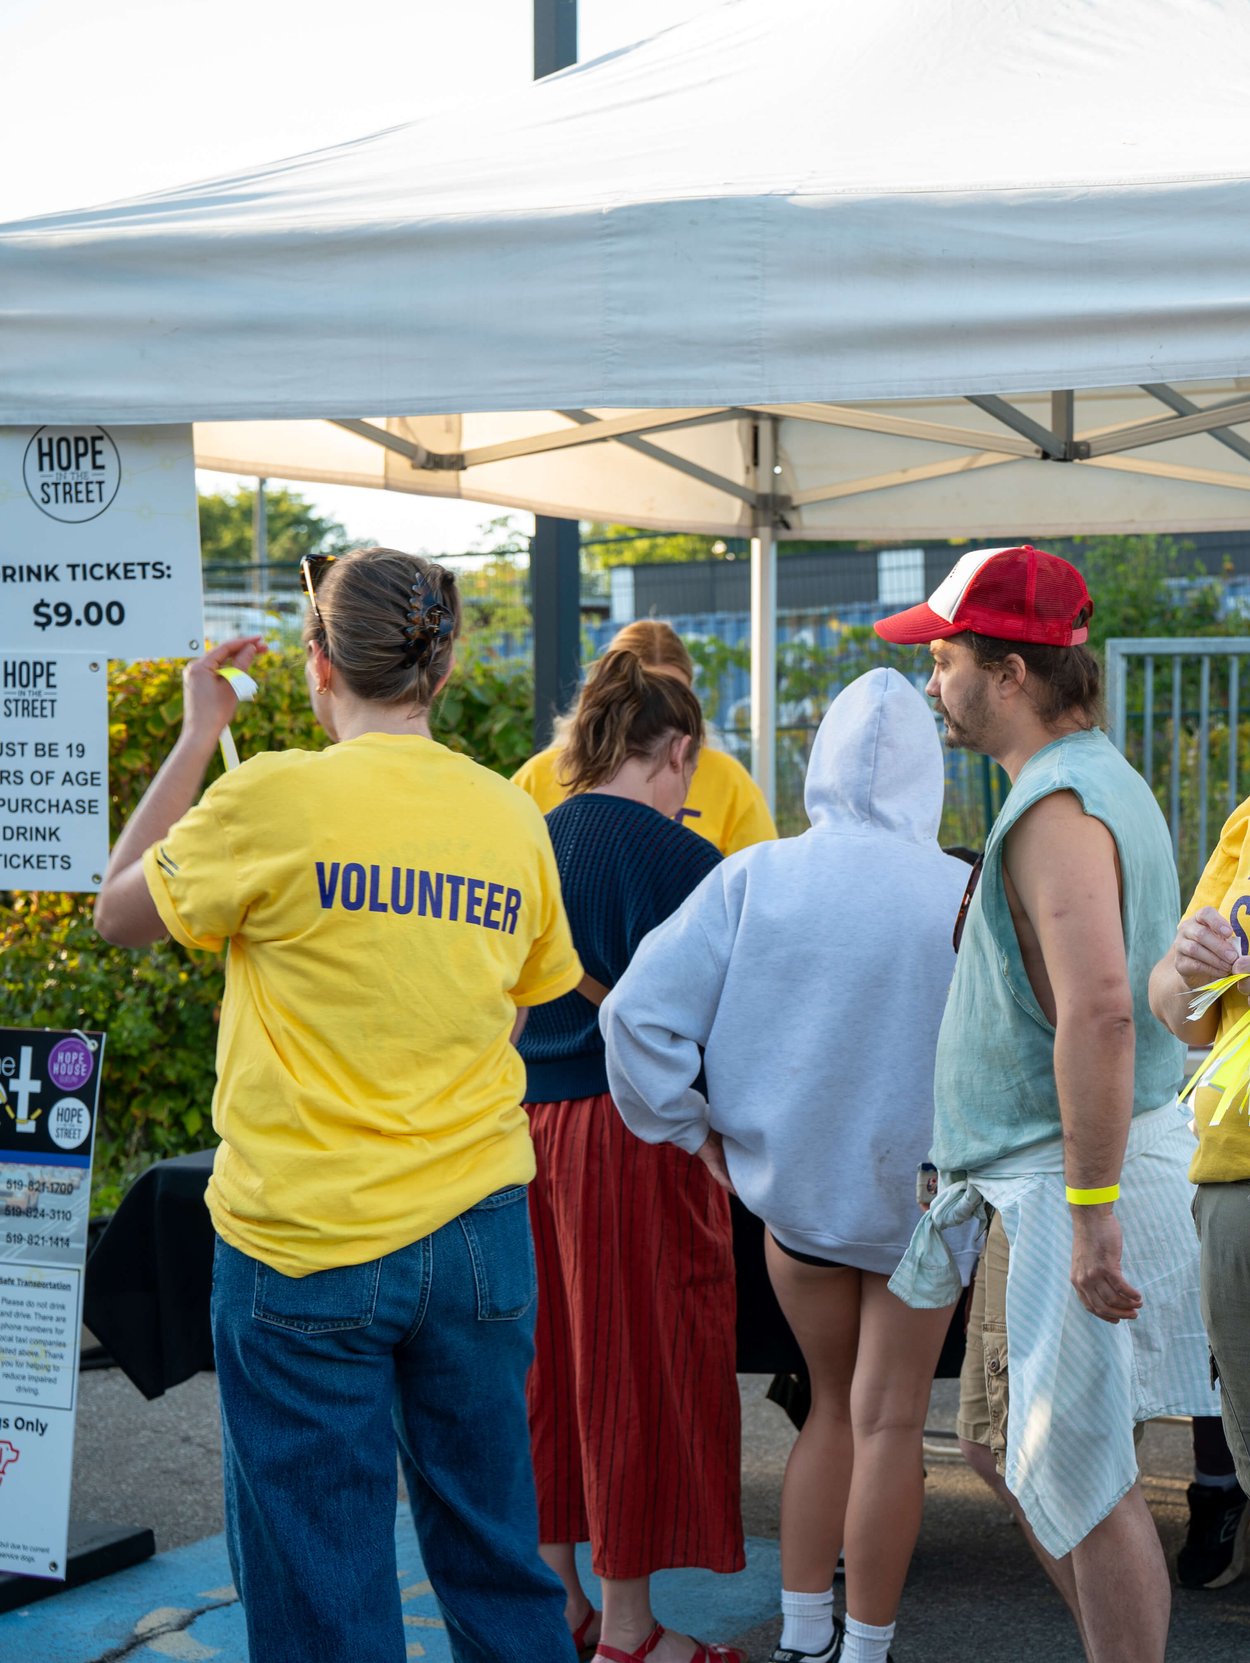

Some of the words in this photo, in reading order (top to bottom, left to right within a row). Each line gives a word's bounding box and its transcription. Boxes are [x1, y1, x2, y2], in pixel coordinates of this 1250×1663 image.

[37, 435, 106, 472] HOPE
[55, 472, 67, 481] IN
[71, 471, 89, 481] THE
[41, 480, 105, 504] STREET
[0, 563, 61, 582] RINK
[67, 561, 172, 581] TICKETS:
[33, 599, 125, 632] $9.00
[3, 660, 57, 689] HOPE
[28, 690, 42, 698] THE
[4, 698, 57, 718] STREET
[34, 742, 59, 758] BE
[66, 742, 85, 758] 19
[30, 770, 55, 786] OF
[61, 771, 101, 787] AGE
[3, 826, 61, 842] DRINK
[315, 861, 522, 935] VOLUNTEER
[57, 1051, 85, 1065] HOPE
[53, 1062, 88, 1077] HOUSE
[56, 1106, 84, 1124] HOPE
[55, 1127, 82, 1140] STREET
[14, 1416, 48, 1436] Only
